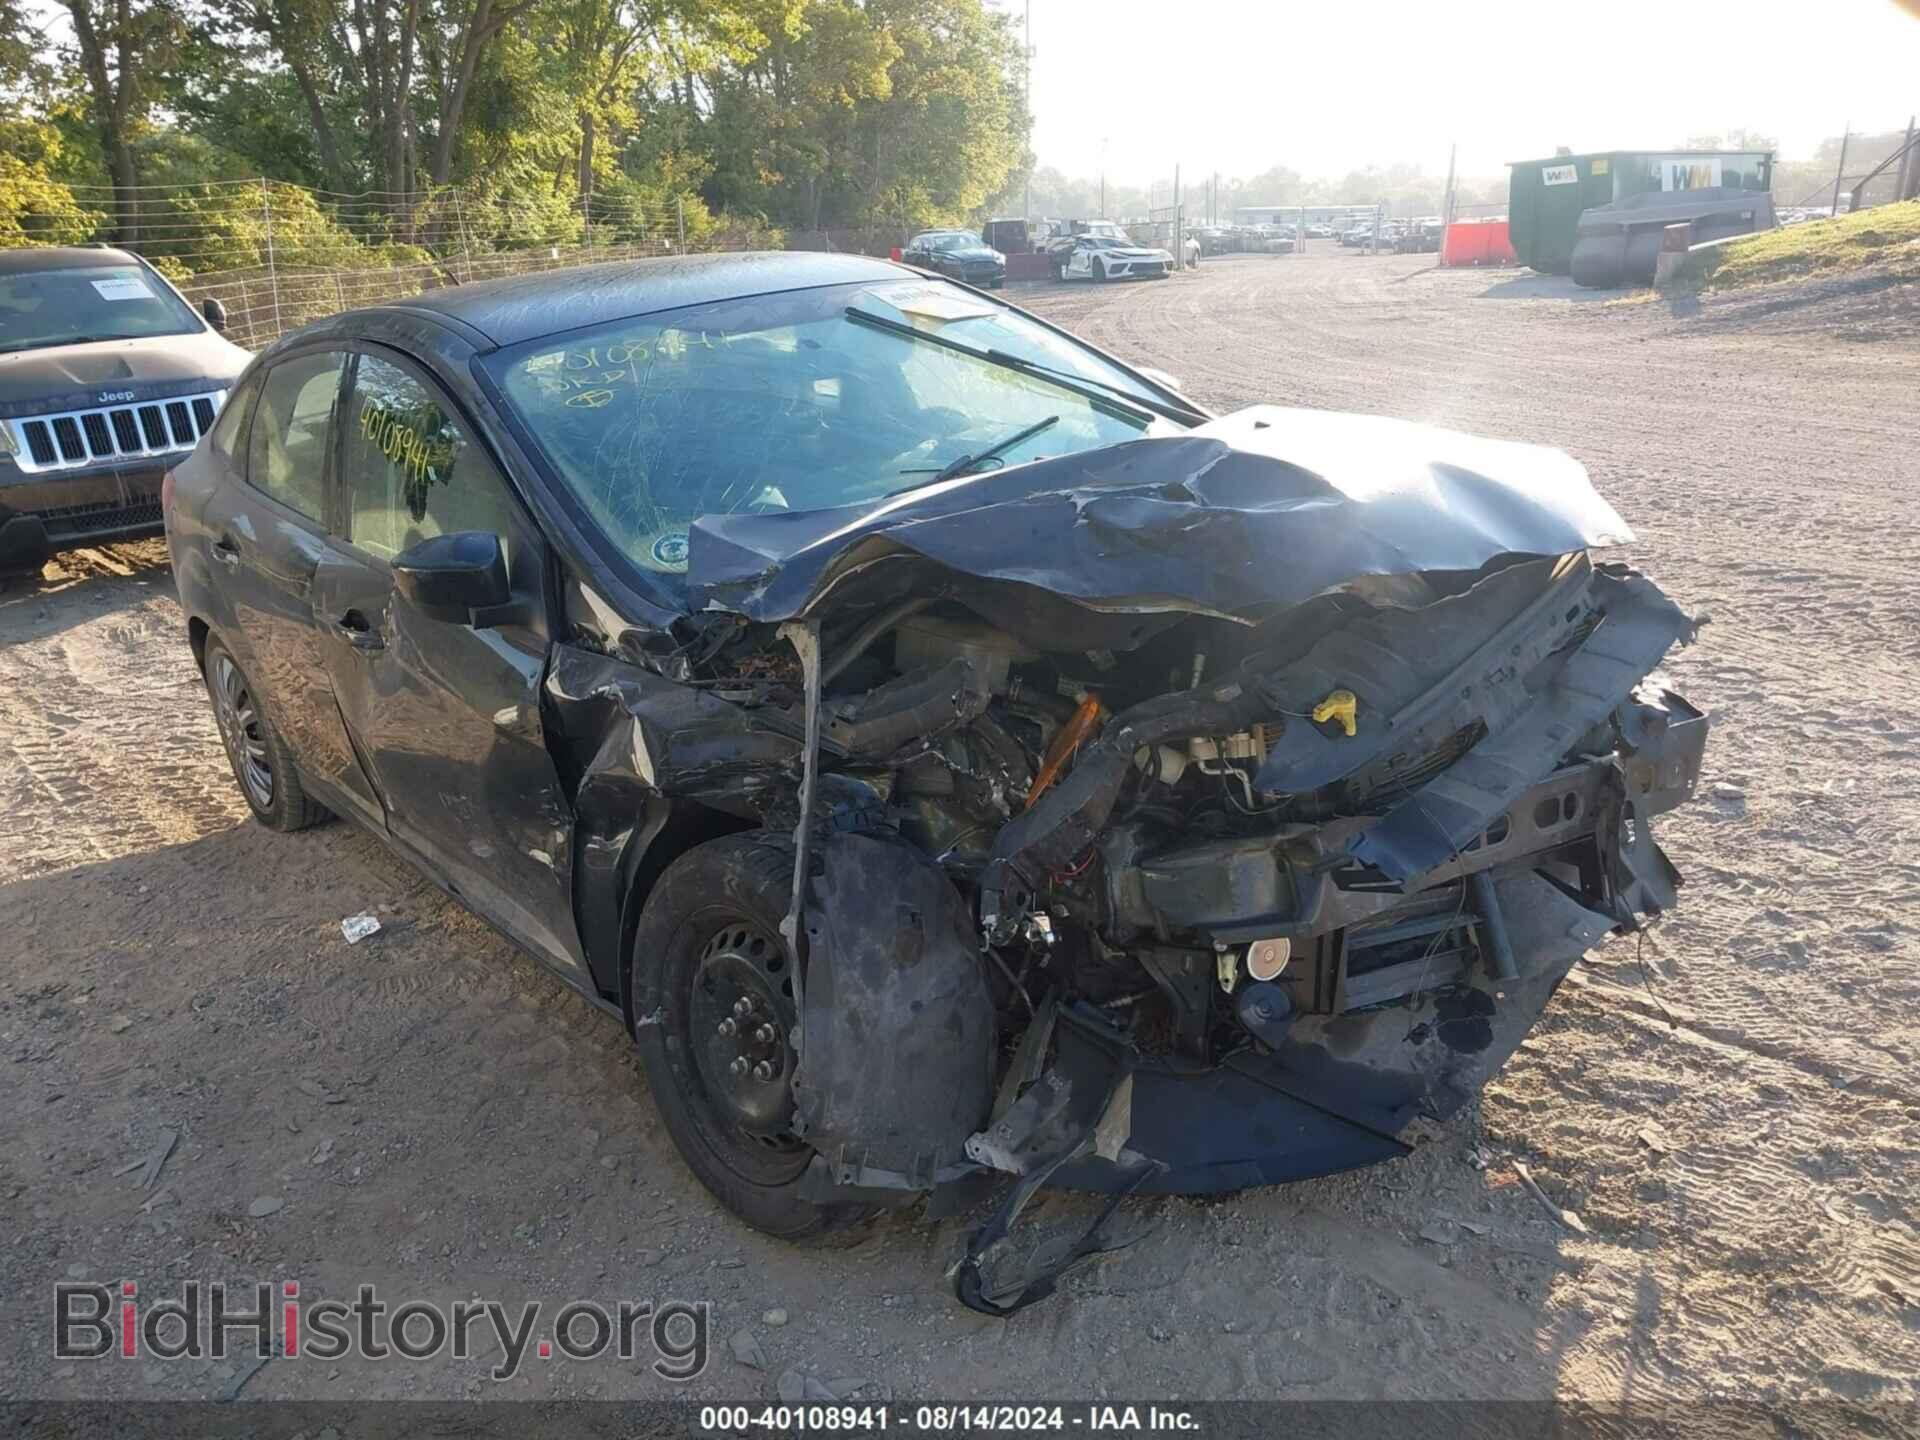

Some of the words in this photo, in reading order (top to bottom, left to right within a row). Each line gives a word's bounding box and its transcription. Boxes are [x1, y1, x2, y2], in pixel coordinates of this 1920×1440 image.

[1672, 165, 1712, 191] WM
[98, 391, 135, 403] Jeep
[360, 398, 430, 482] 40108941
